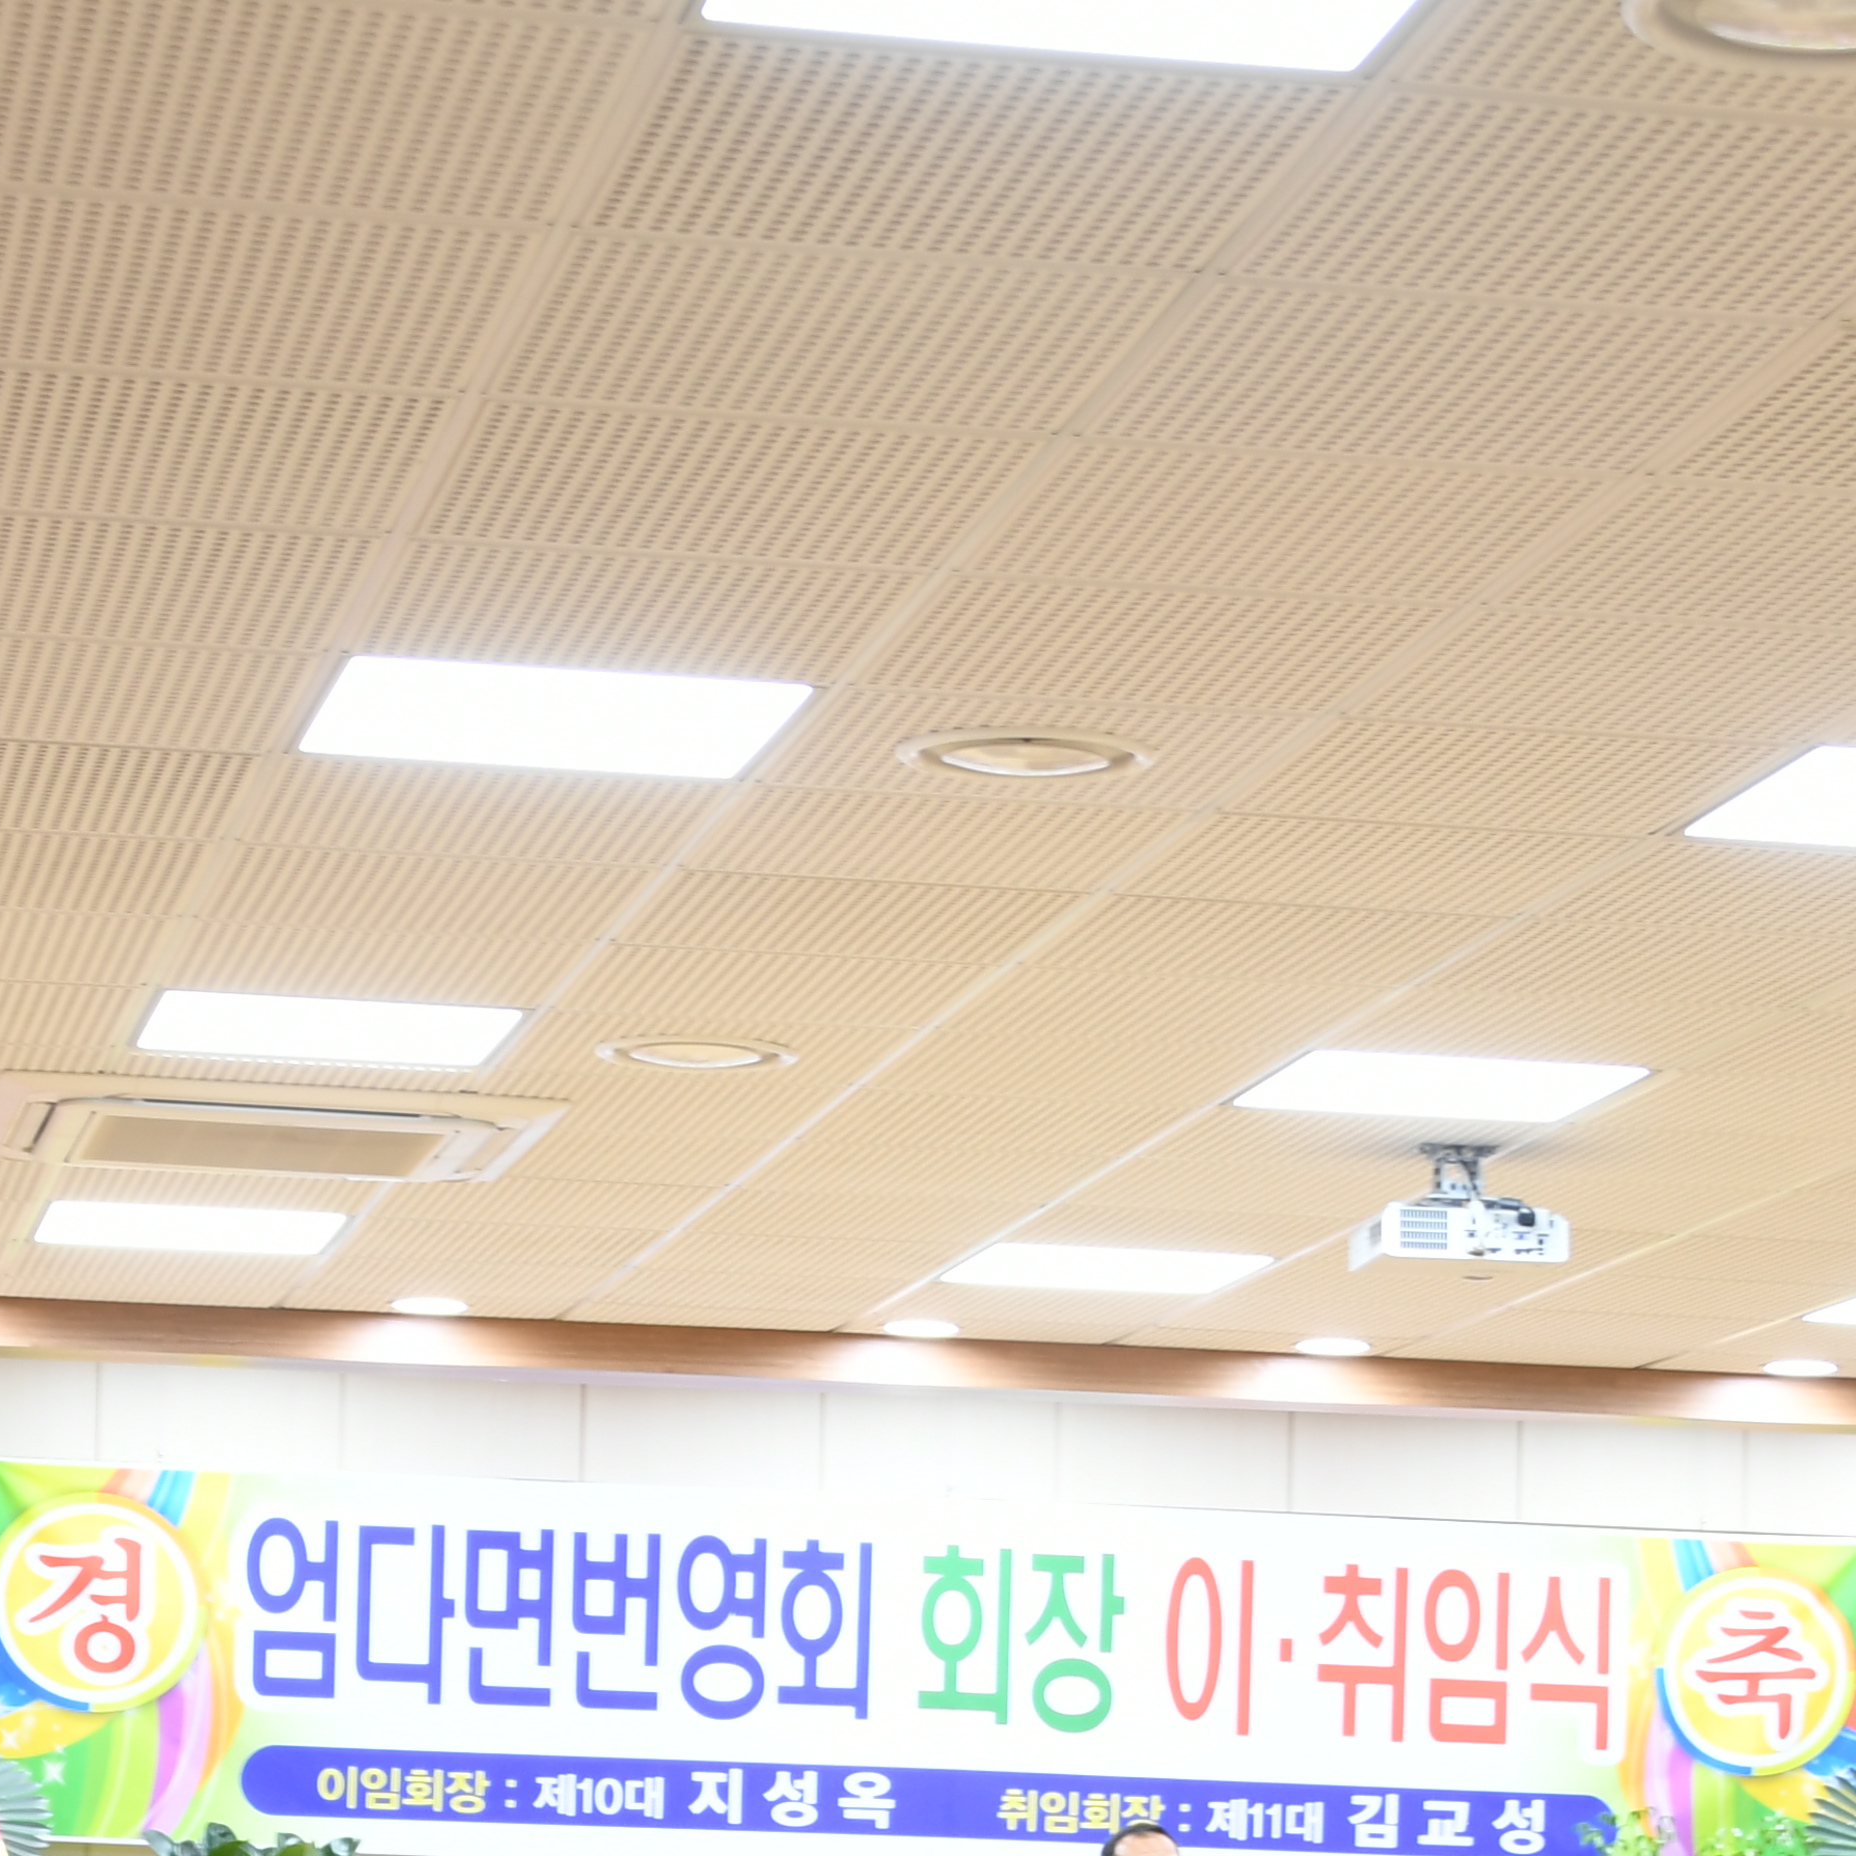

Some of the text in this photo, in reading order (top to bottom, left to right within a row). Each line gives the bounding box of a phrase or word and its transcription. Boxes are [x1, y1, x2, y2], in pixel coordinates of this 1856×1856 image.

[27, 1535, 145, 1675] 경
[245, 1516, 873, 1720] 엄다면번영회
[917, 1542, 1125, 1735] 회장
[1695, 1608, 1817, 1740] 축
[317, 1765, 488, 1812] 이임회장
[534, 1778, 663, 1819] 제10대
[997, 1788, 1166, 1833] 취임회장
[1206, 1801, 1324, 1844] 제11대
